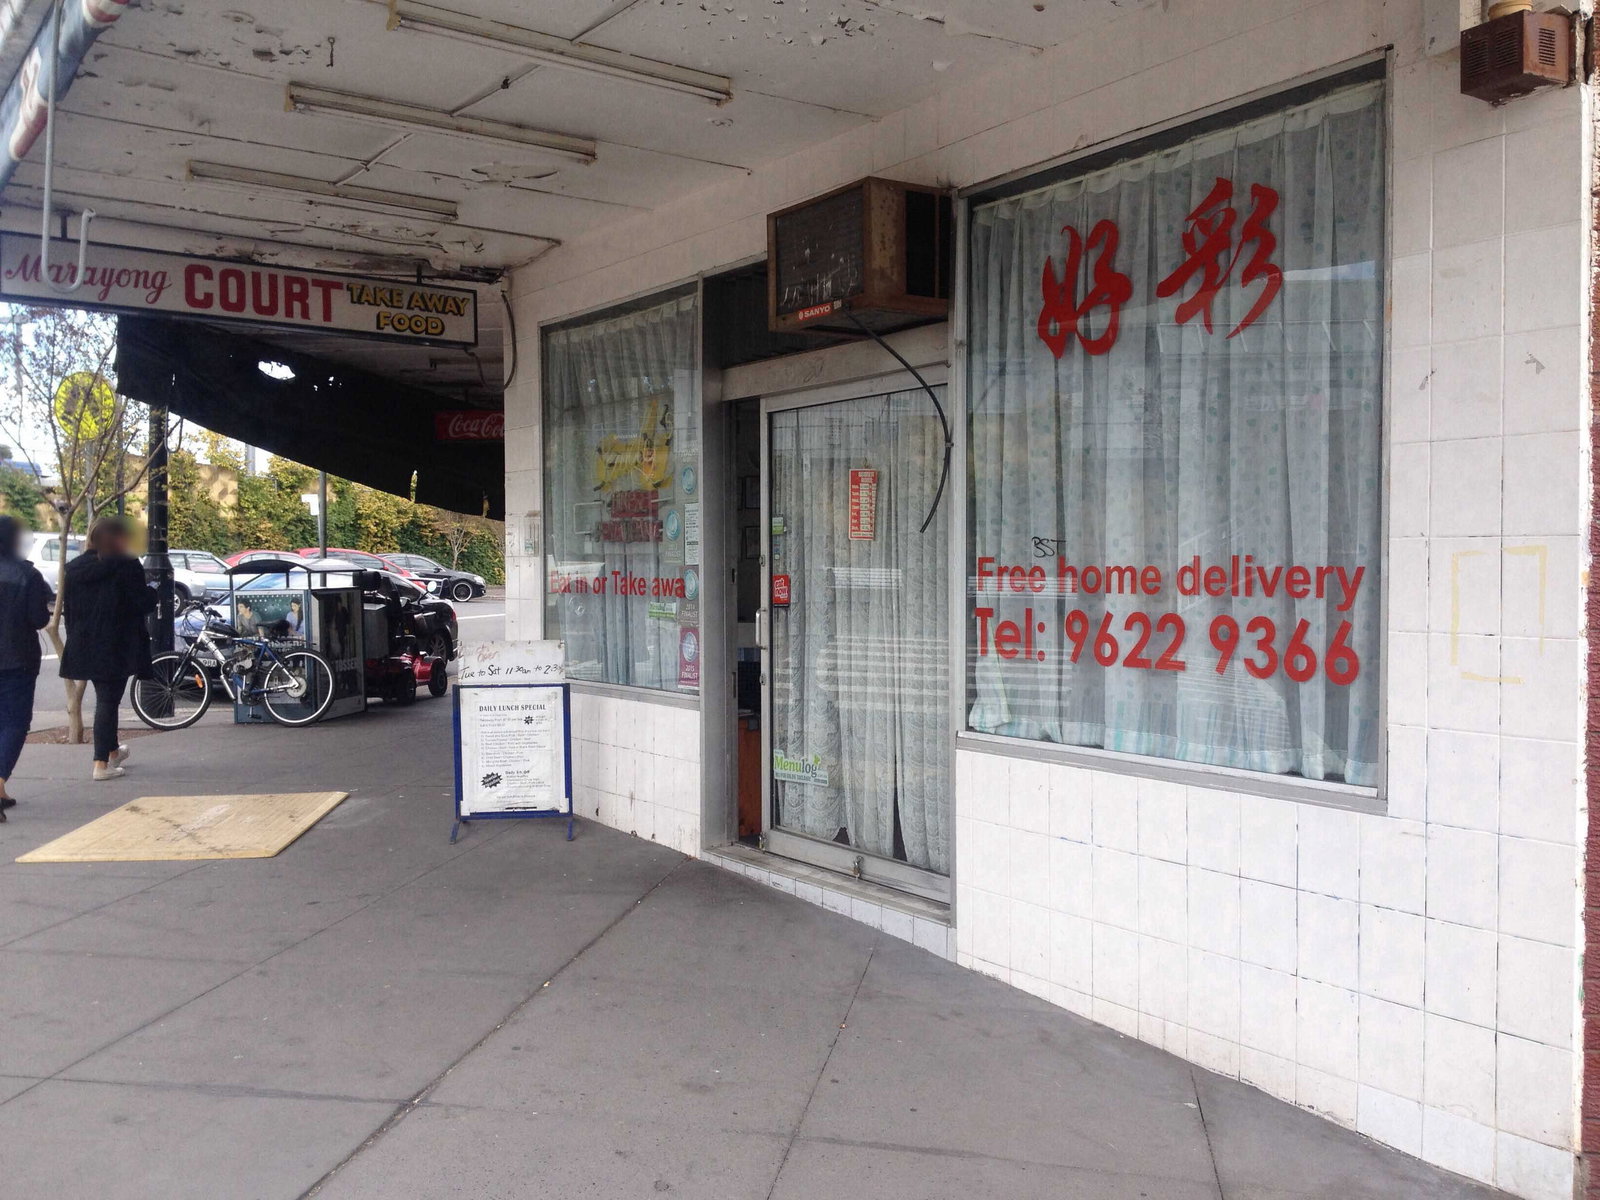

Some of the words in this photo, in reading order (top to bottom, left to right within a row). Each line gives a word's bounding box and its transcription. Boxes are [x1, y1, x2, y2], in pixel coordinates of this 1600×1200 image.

[5, 254, 172, 304] Marayong
[185, 264, 344, 322] COURT
[346, 282, 404, 308] TAKE
[407, 291, 471, 316] AWAY
[376, 311, 445, 335] FOOD
[804, 305, 831, 318] SANYO
[550, 570, 571, 594] Eat
[575, 570, 588, 594] in
[592, 577, 608, 595] or
[611, 570, 647, 596] Take
[652, 576, 686, 598] awa
[977, 556, 1046, 592] Free
[1058, 555, 1162, 595] home
[1176, 555, 1366, 611] delivery
[975, 607, 1046, 662] Tel:
[1065, 608, 1186, 671] 9622
[1208, 615, 1360, 685] 9366
[477, 669, 486, 677] to
[487, 664, 502, 676] Sat
[774, 755, 818, 778] Menulog
